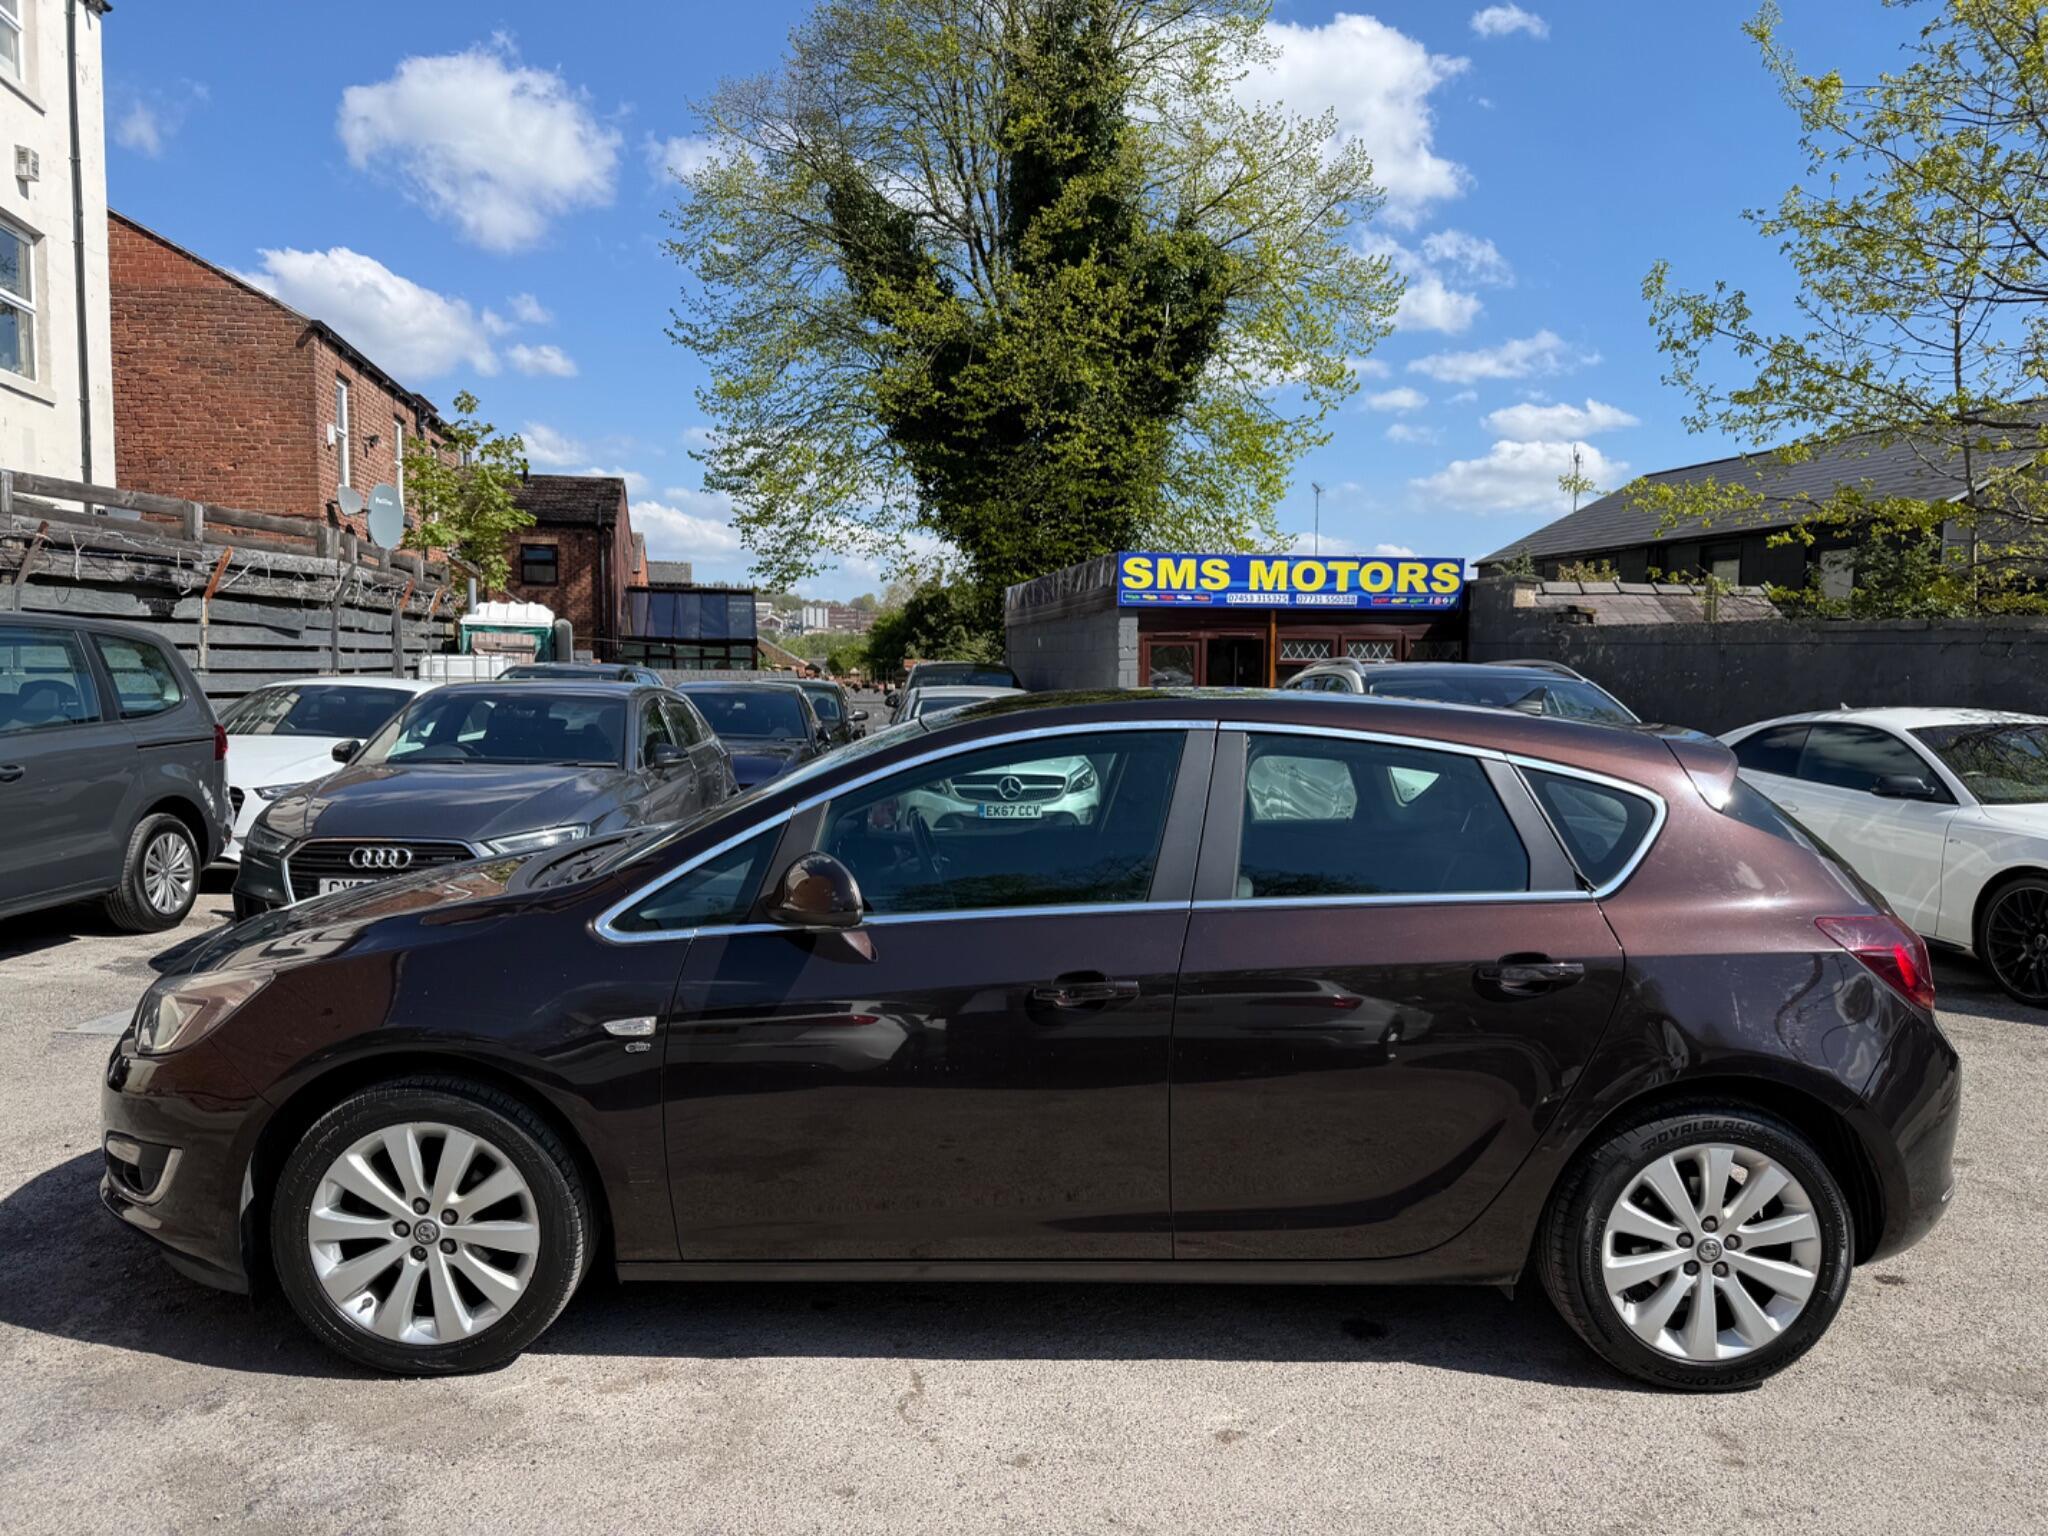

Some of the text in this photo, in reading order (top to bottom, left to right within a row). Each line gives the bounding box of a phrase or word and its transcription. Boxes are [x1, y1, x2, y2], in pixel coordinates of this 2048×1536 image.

[1122, 557, 1462, 594] SMS MOTORS
[986, 805, 1041, 817] EK67 CCV
